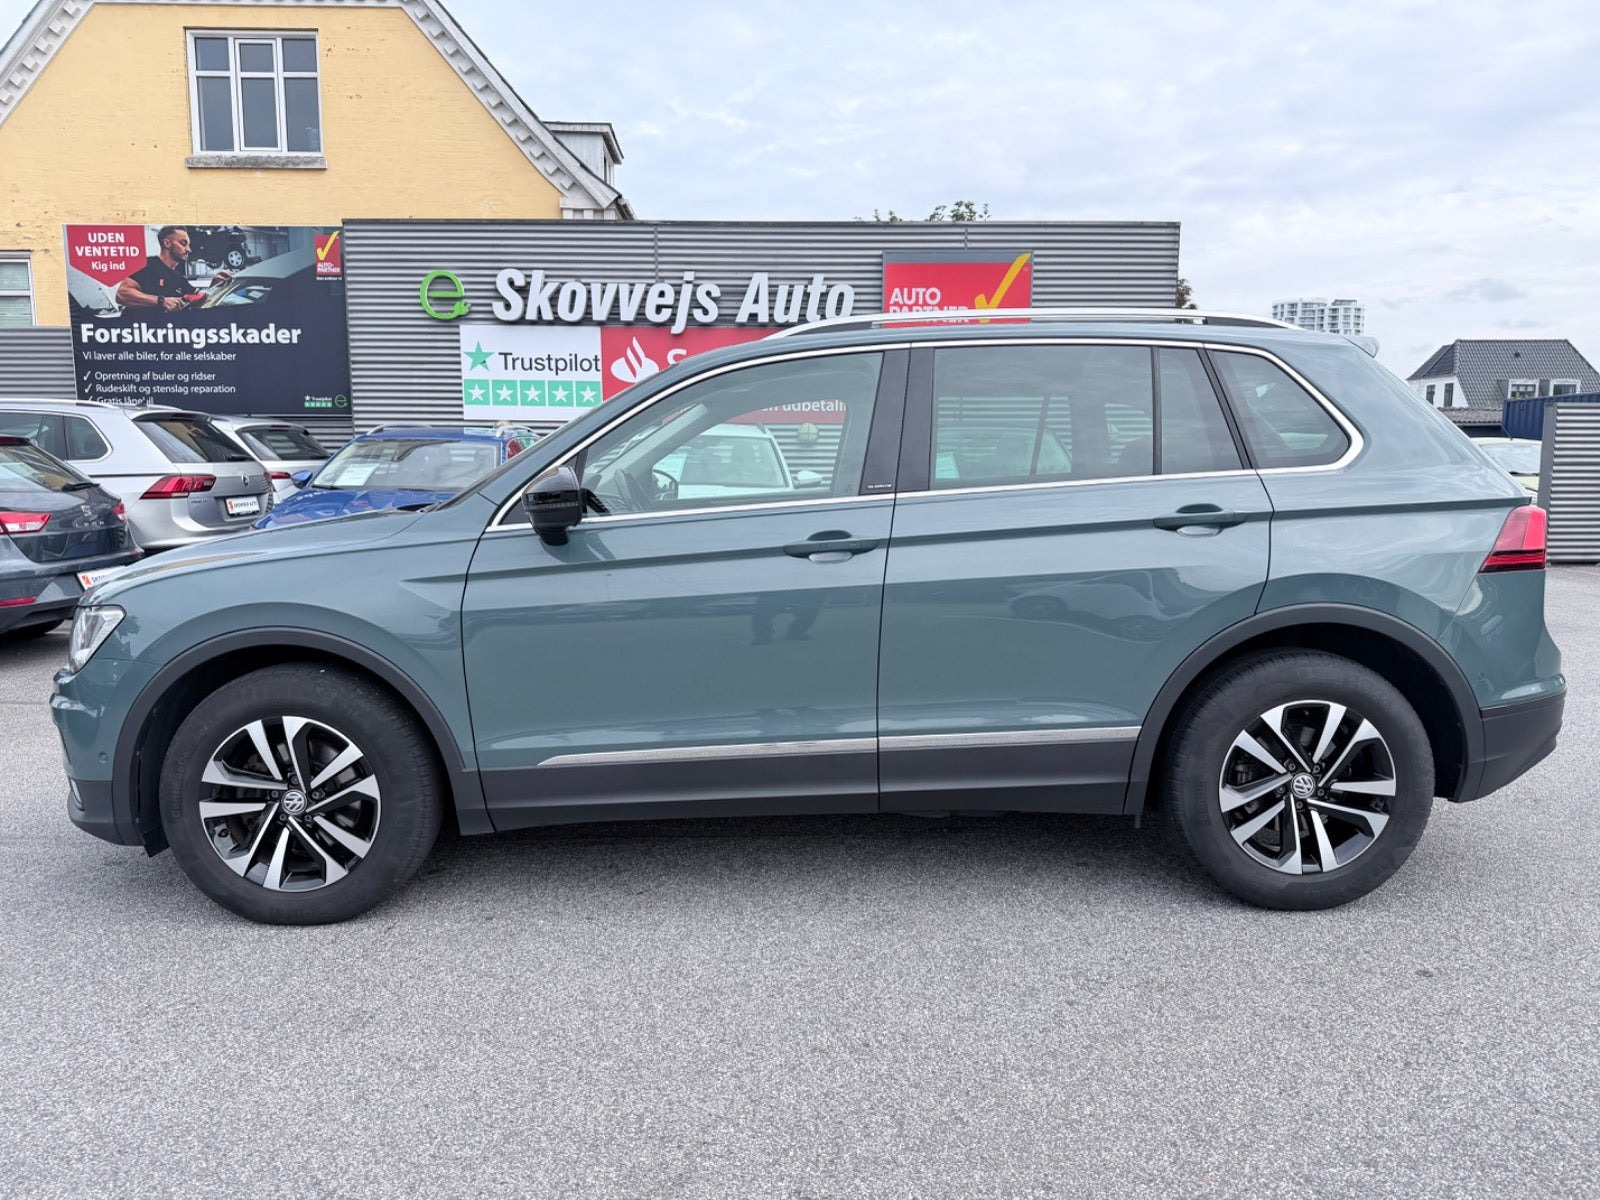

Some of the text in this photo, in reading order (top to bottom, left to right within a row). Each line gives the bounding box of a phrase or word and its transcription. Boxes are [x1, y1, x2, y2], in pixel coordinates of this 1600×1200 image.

[88, 233, 125, 243] UDEN
[75, 246, 140, 257] VENTETID
[91, 261, 126, 272] Kig ind
[491, 268, 855, 335] Skovvejs Auto
[889, 287, 942, 305] AUTO
[81, 322, 302, 349] Forsikringsskader
[82, 351, 237, 361] Vi laver alle biler, for alle selskaber
[498, 352, 601, 376] Trustpilot
[94, 371, 216, 382] Opretning af buler og ridser
[95, 384, 236, 395] Rudeskift og stenslag reparation
